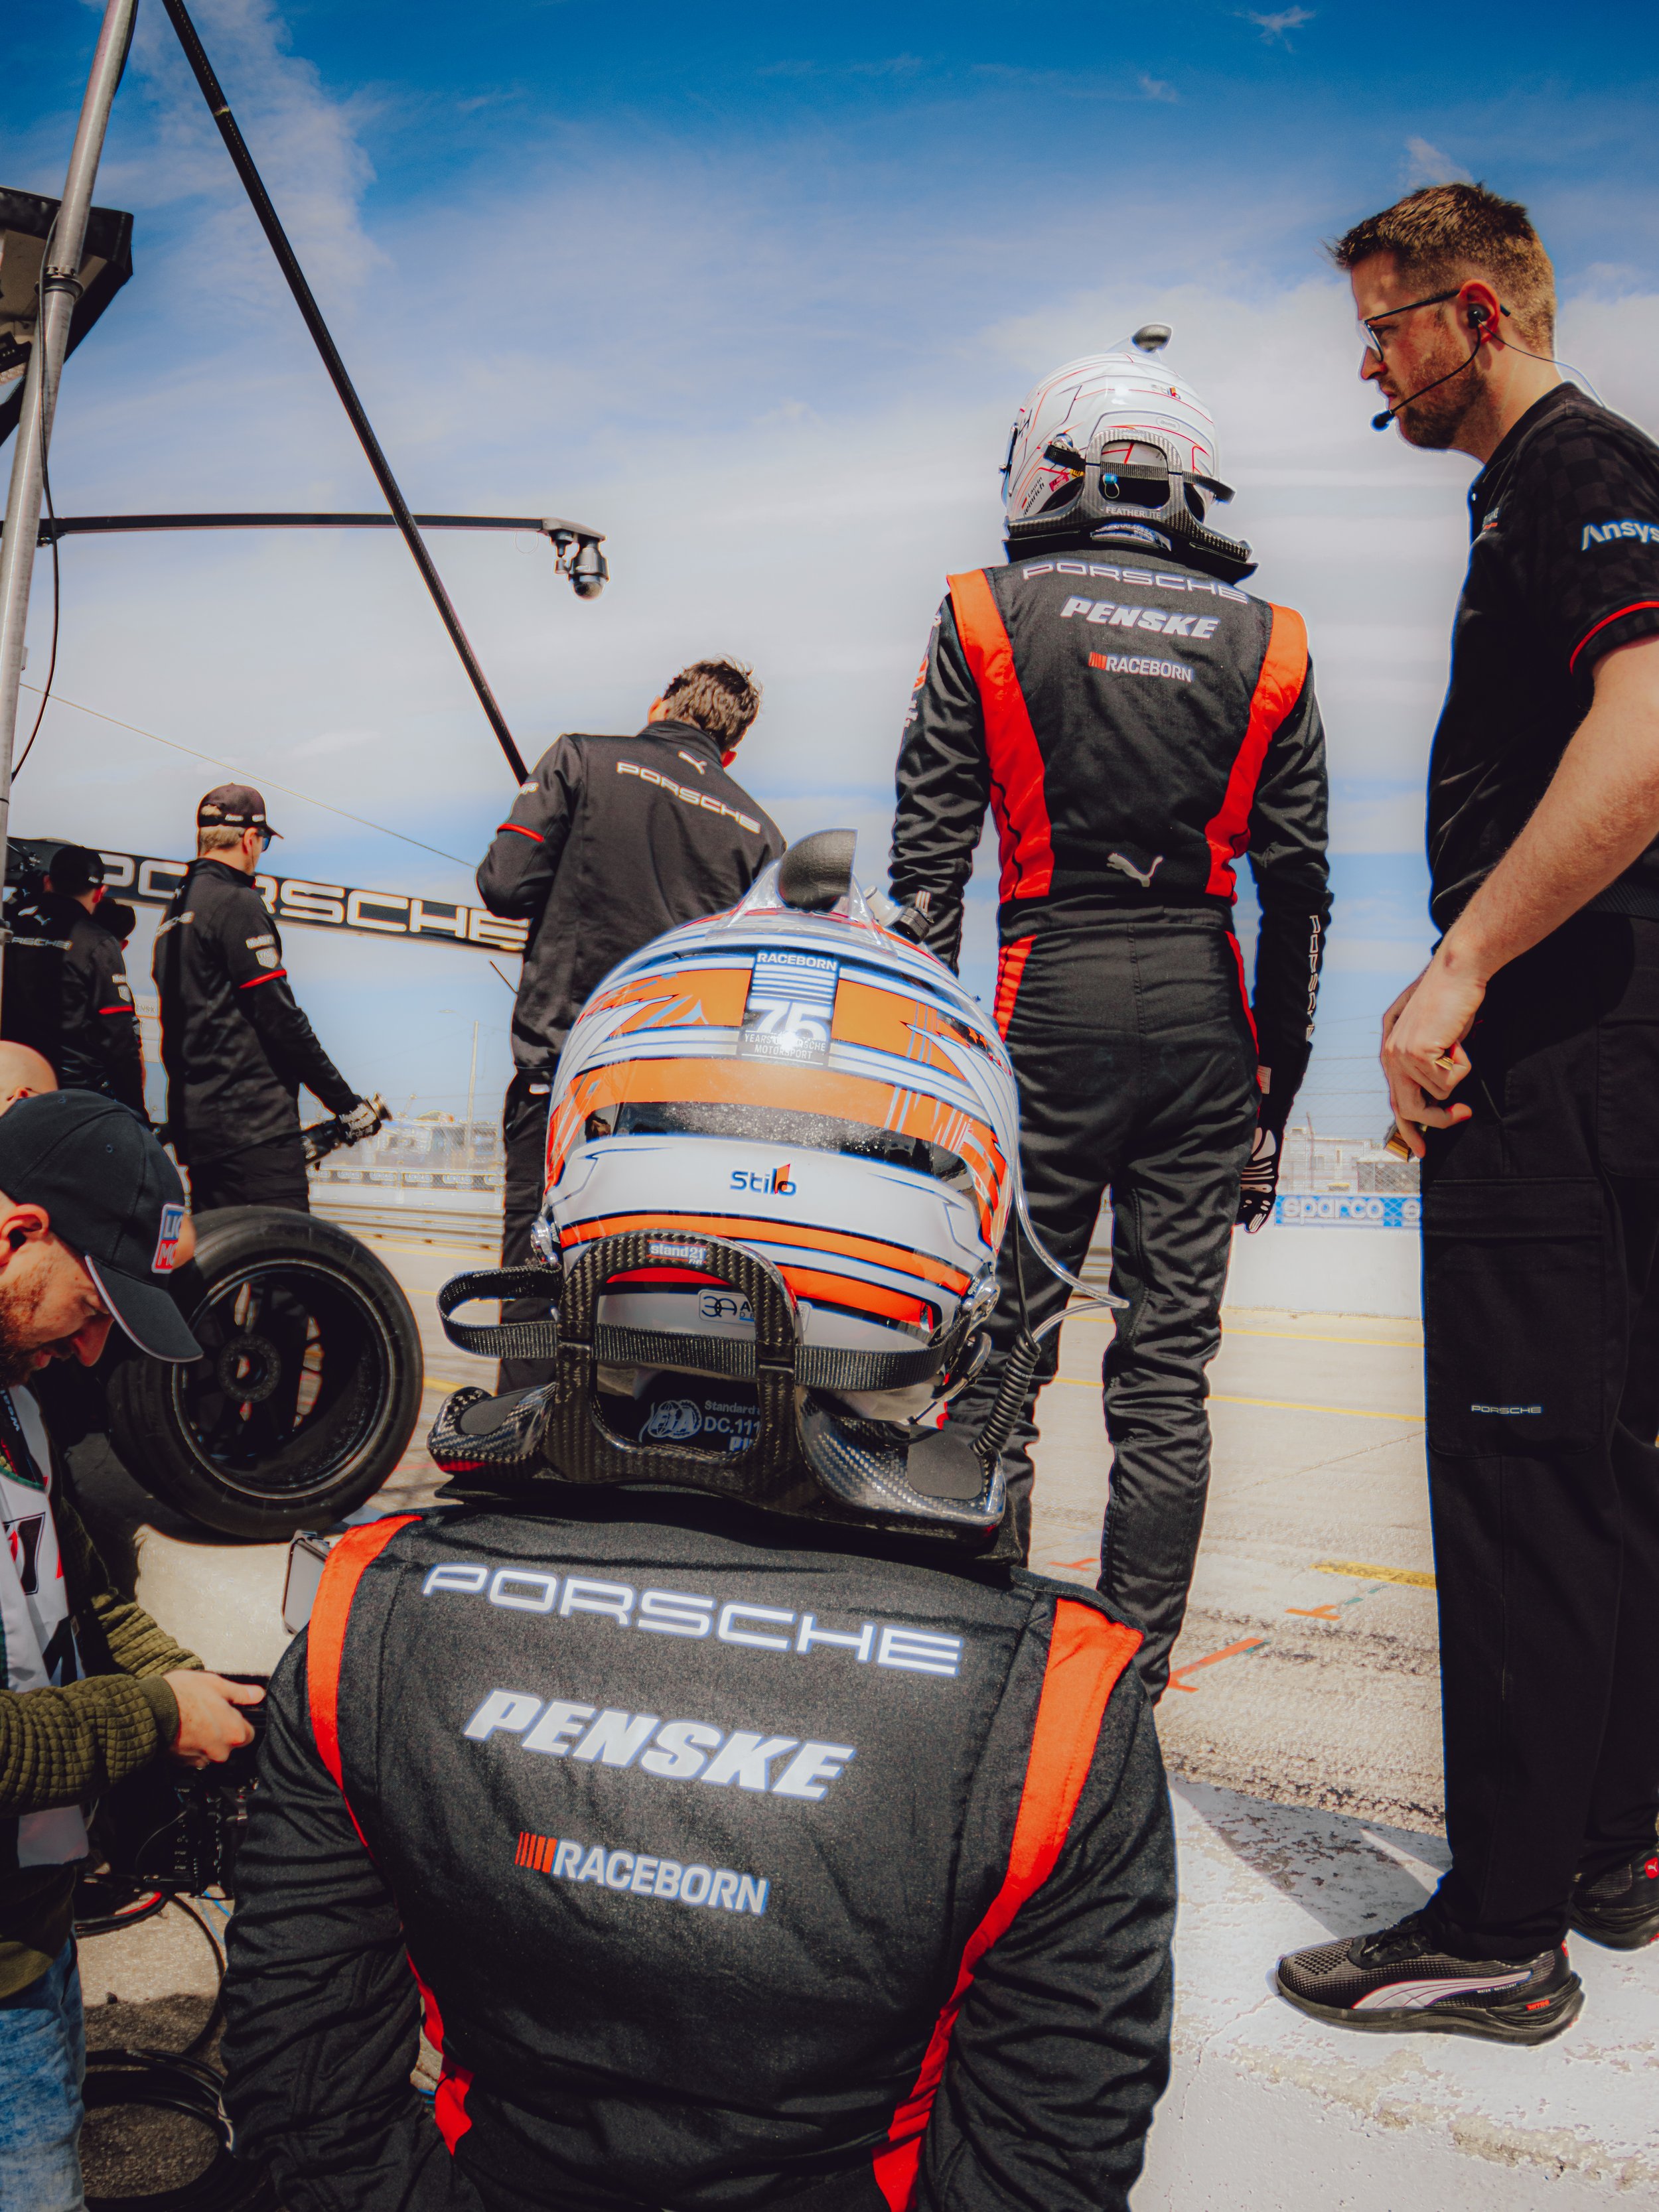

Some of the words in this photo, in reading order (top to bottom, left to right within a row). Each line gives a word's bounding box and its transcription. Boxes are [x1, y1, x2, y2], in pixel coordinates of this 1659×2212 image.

[1106, 506, 1162, 520] FEATHERLITE
[1023, 562, 1248, 605] PORSCHE
[1060, 597, 1220, 640] PENSKE
[1106, 655, 1192, 683] RACEBORN
[616, 761, 762, 834] PORSCHE
[757, 952, 838, 972] RACEBORN
[749, 998, 832, 1044] 75
[744, 1033, 772, 1044] YEARS
[754, 1044, 813, 1060] MOTORSPORT
[730, 1165, 796, 1196] Stilo
[1282, 1198, 1384, 1225] sparco
[704, 1399, 755, 1415] Standard
[1471, 1405, 1542, 1415] PORSCHE
[423, 1564, 962, 1676] PORSCHE
[465, 1690, 855, 1799] PENSKE
[553, 1840, 770, 1915] RACEBORN
